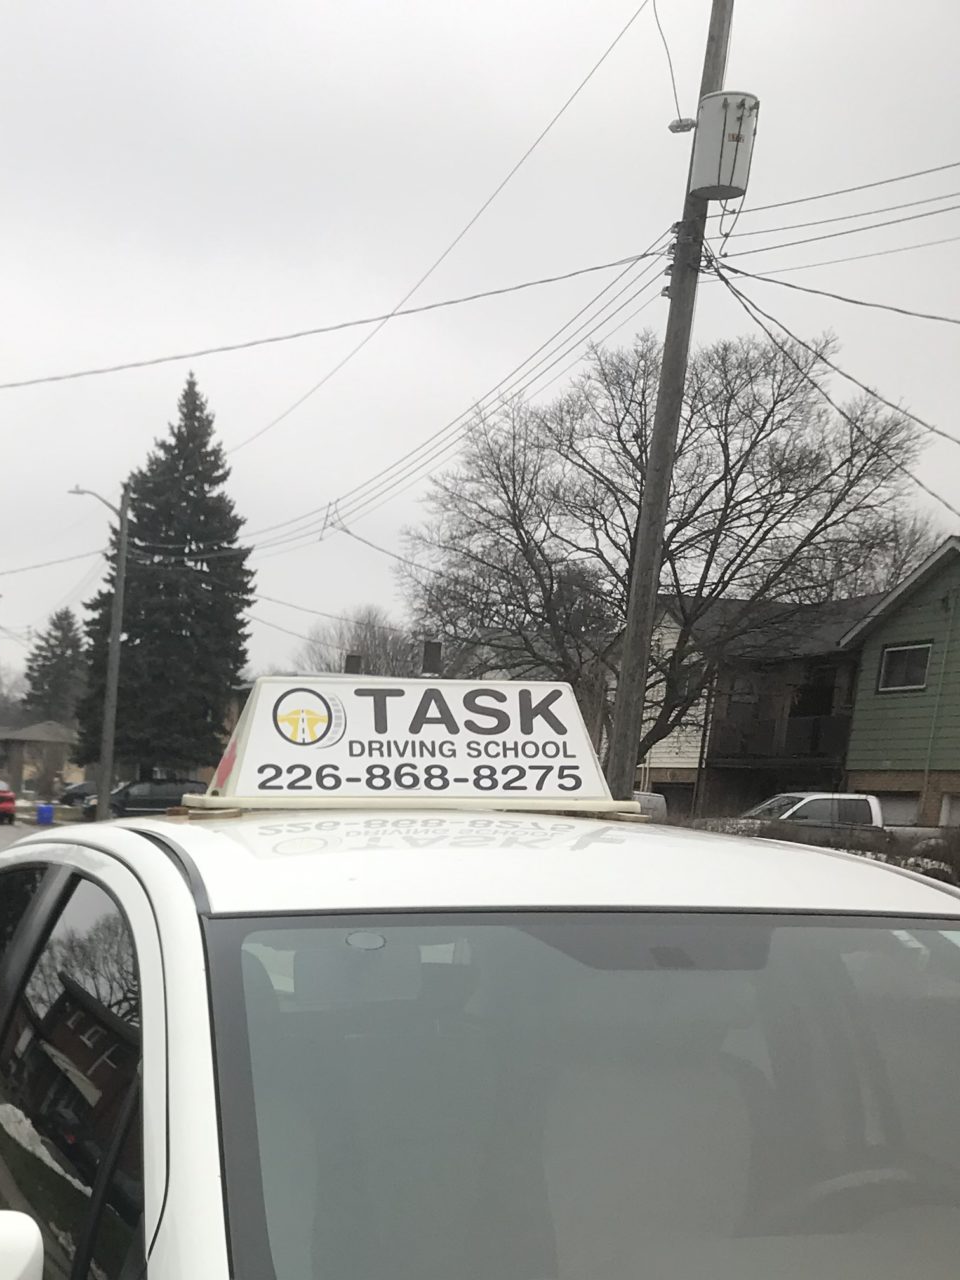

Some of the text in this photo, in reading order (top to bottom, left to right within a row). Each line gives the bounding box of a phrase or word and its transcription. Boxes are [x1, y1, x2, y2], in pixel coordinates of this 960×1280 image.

[354, 688, 568, 736] TASK
[348, 740, 577, 759] DRIVING SCHOOL
[257, 763, 583, 792] 226-868-8275
